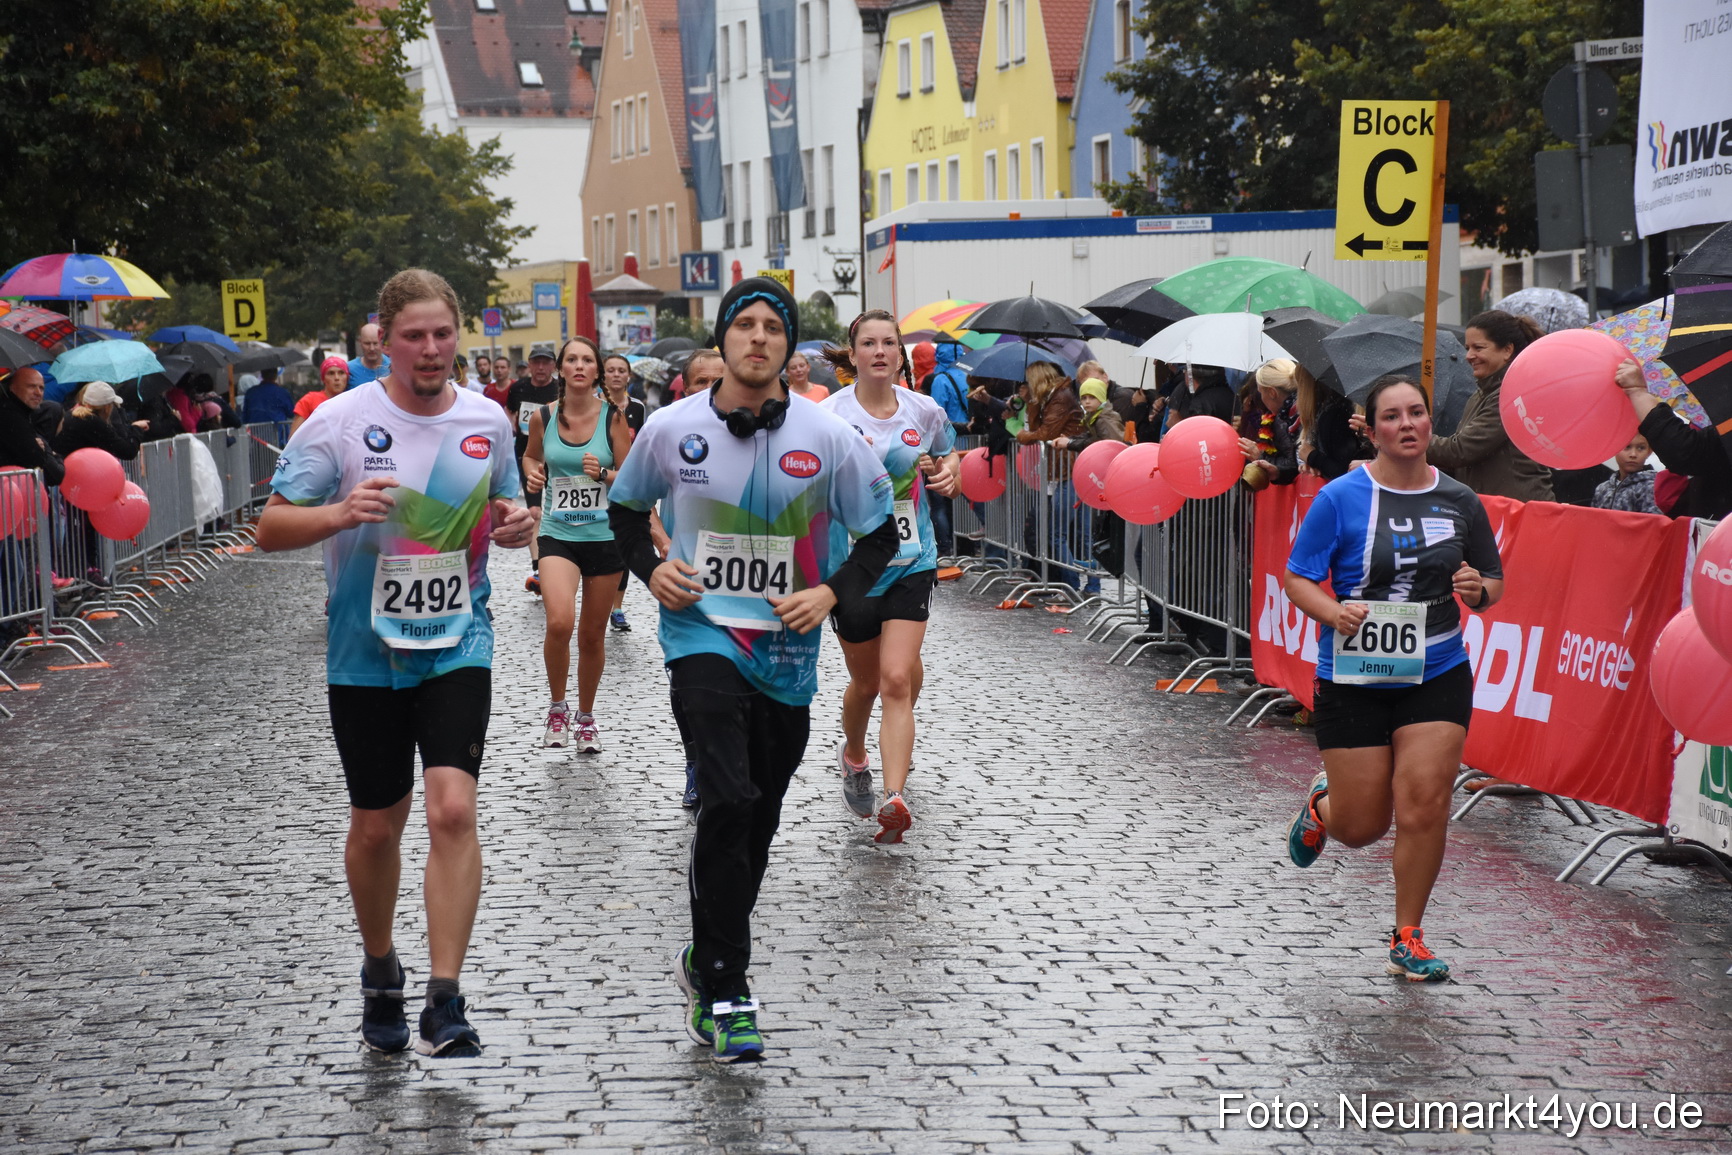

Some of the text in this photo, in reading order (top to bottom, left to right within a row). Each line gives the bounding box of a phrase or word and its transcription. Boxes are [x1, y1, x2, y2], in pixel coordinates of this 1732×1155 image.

[1590, 44, 1619, 56] Ulmer
[1353, 107, 1435, 136] Block
[912, 125, 936, 153] HOTEL
[1364, 148, 1418, 226] C
[226, 281, 259, 294] Block
[234, 299, 255, 327] D
[364, 457, 396, 466] PARTL
[785, 456, 817, 471] Hervis
[680, 469, 709, 478] PARTL
[558, 487, 602, 509] 2857
[564, 513, 597, 521] Stefanie
[741, 538, 789, 552] BOCK
[419, 556, 462, 570] BOCK
[703, 556, 788, 594] 3004
[383, 575, 462, 613] 2492
[1374, 604, 1418, 616] BOCK
[401, 623, 446, 637] Florian
[1359, 661, 1395, 676] Jenny
